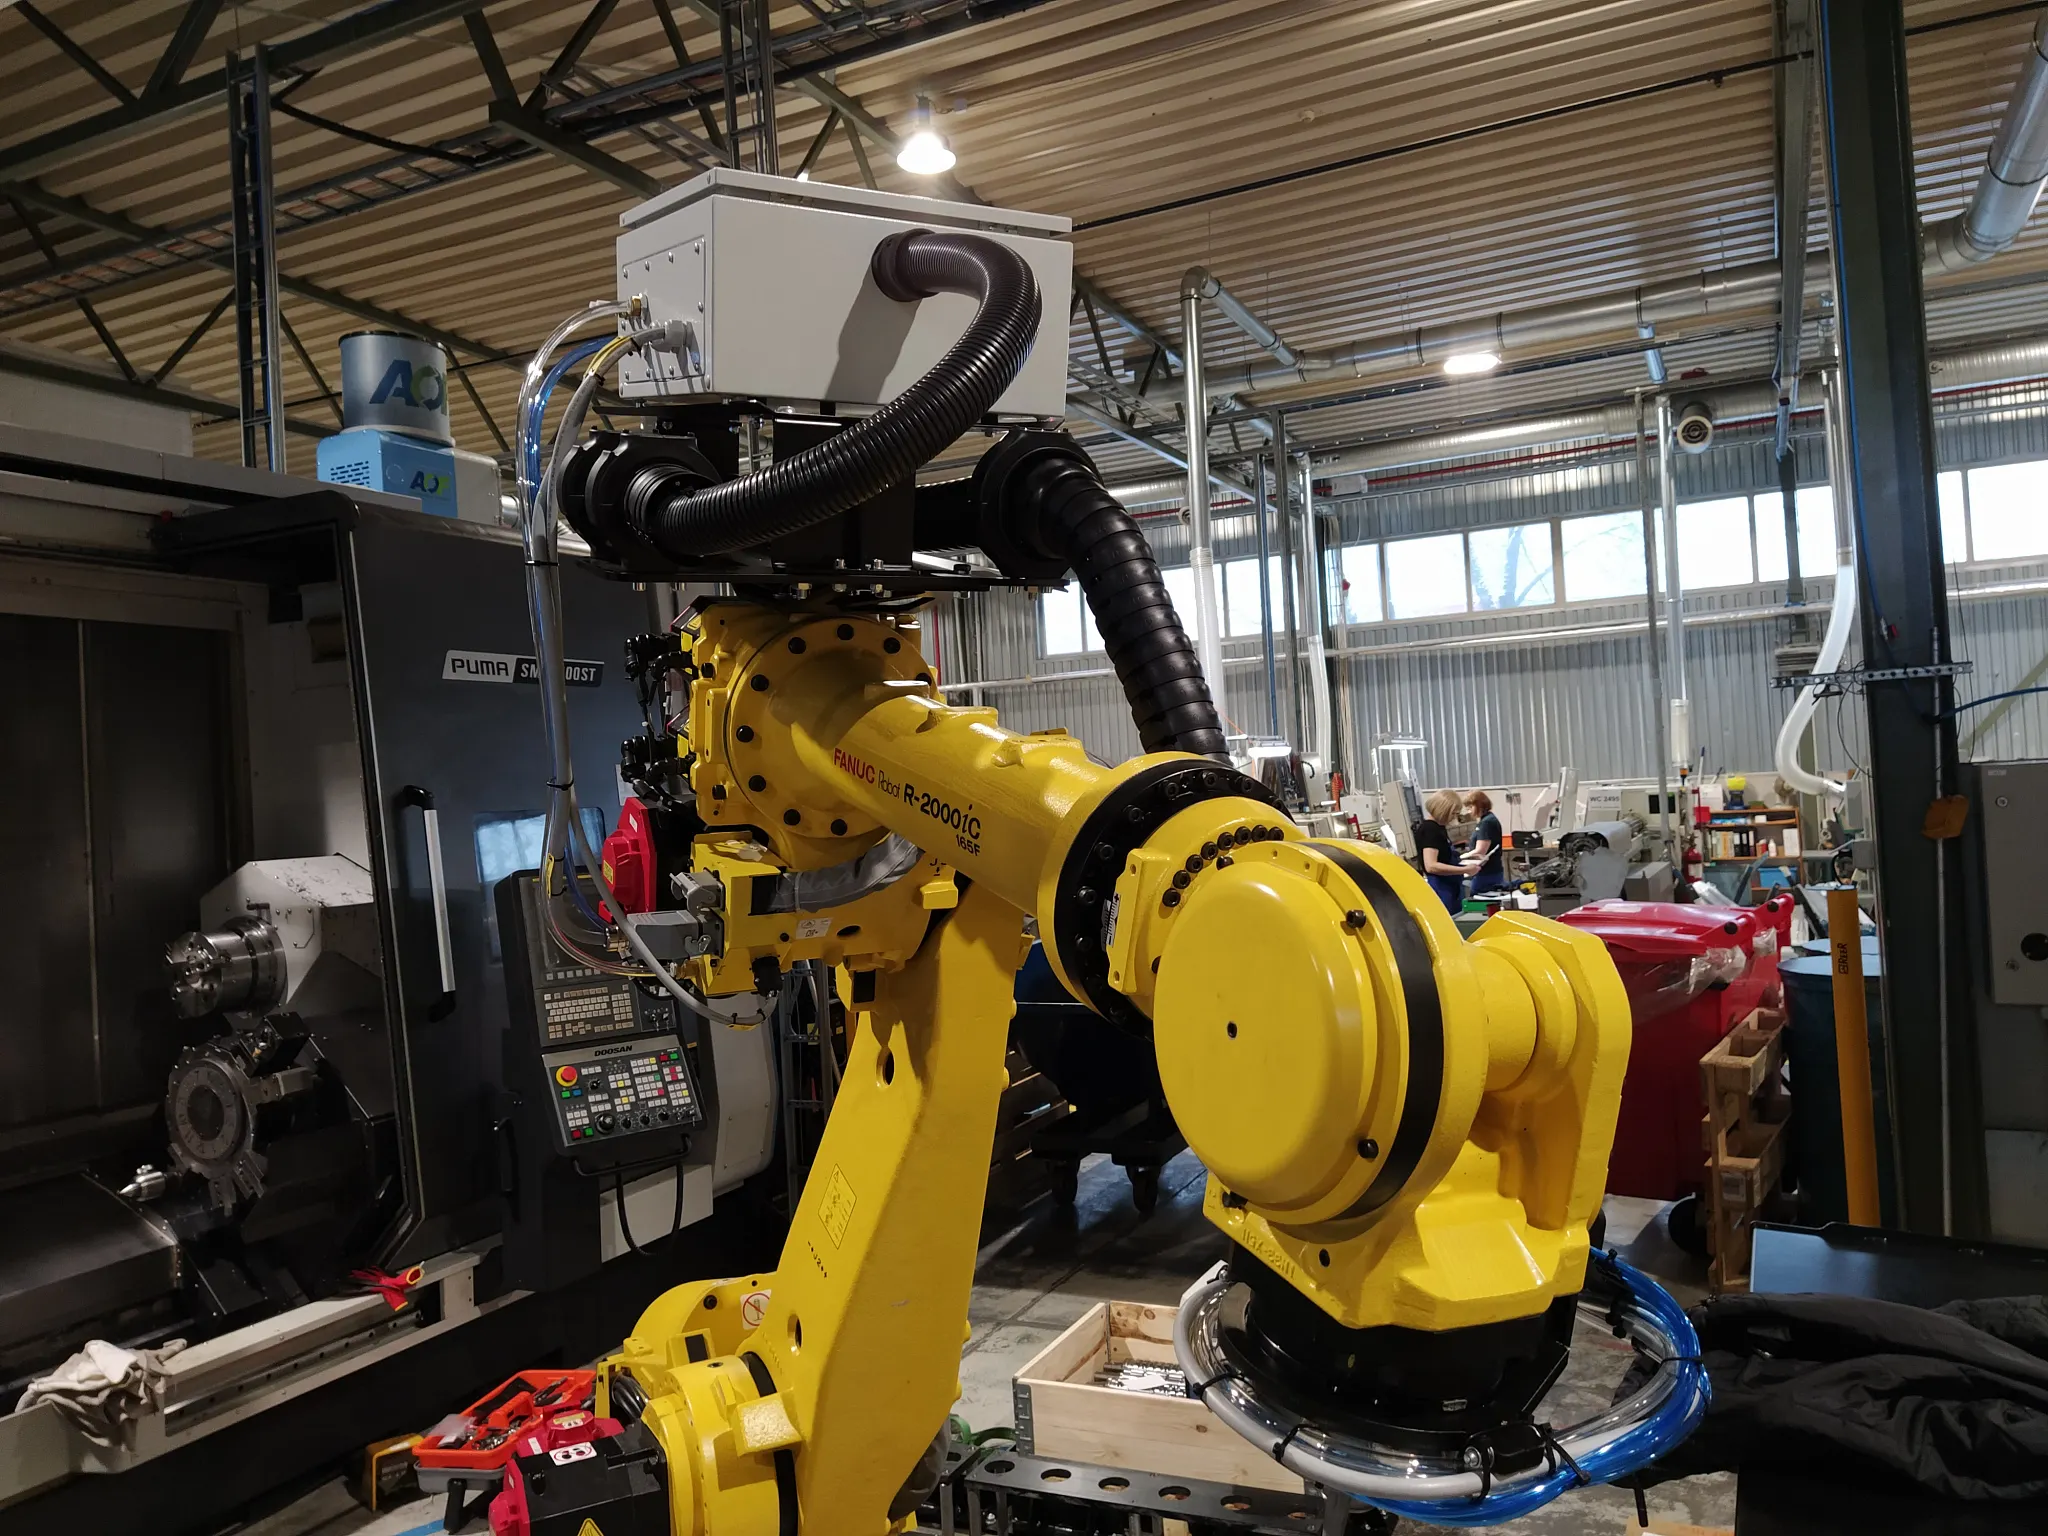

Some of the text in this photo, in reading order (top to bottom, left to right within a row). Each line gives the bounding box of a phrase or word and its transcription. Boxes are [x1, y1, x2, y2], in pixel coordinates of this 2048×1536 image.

[409, 470, 449, 496] AOF
[451, 657, 510, 677] PUMA
[833, 747, 981, 840] FANUC Robot R-2000iC
[955, 833, 981, 857] 165F
[594, 1045, 633, 1057] DOOSAN
